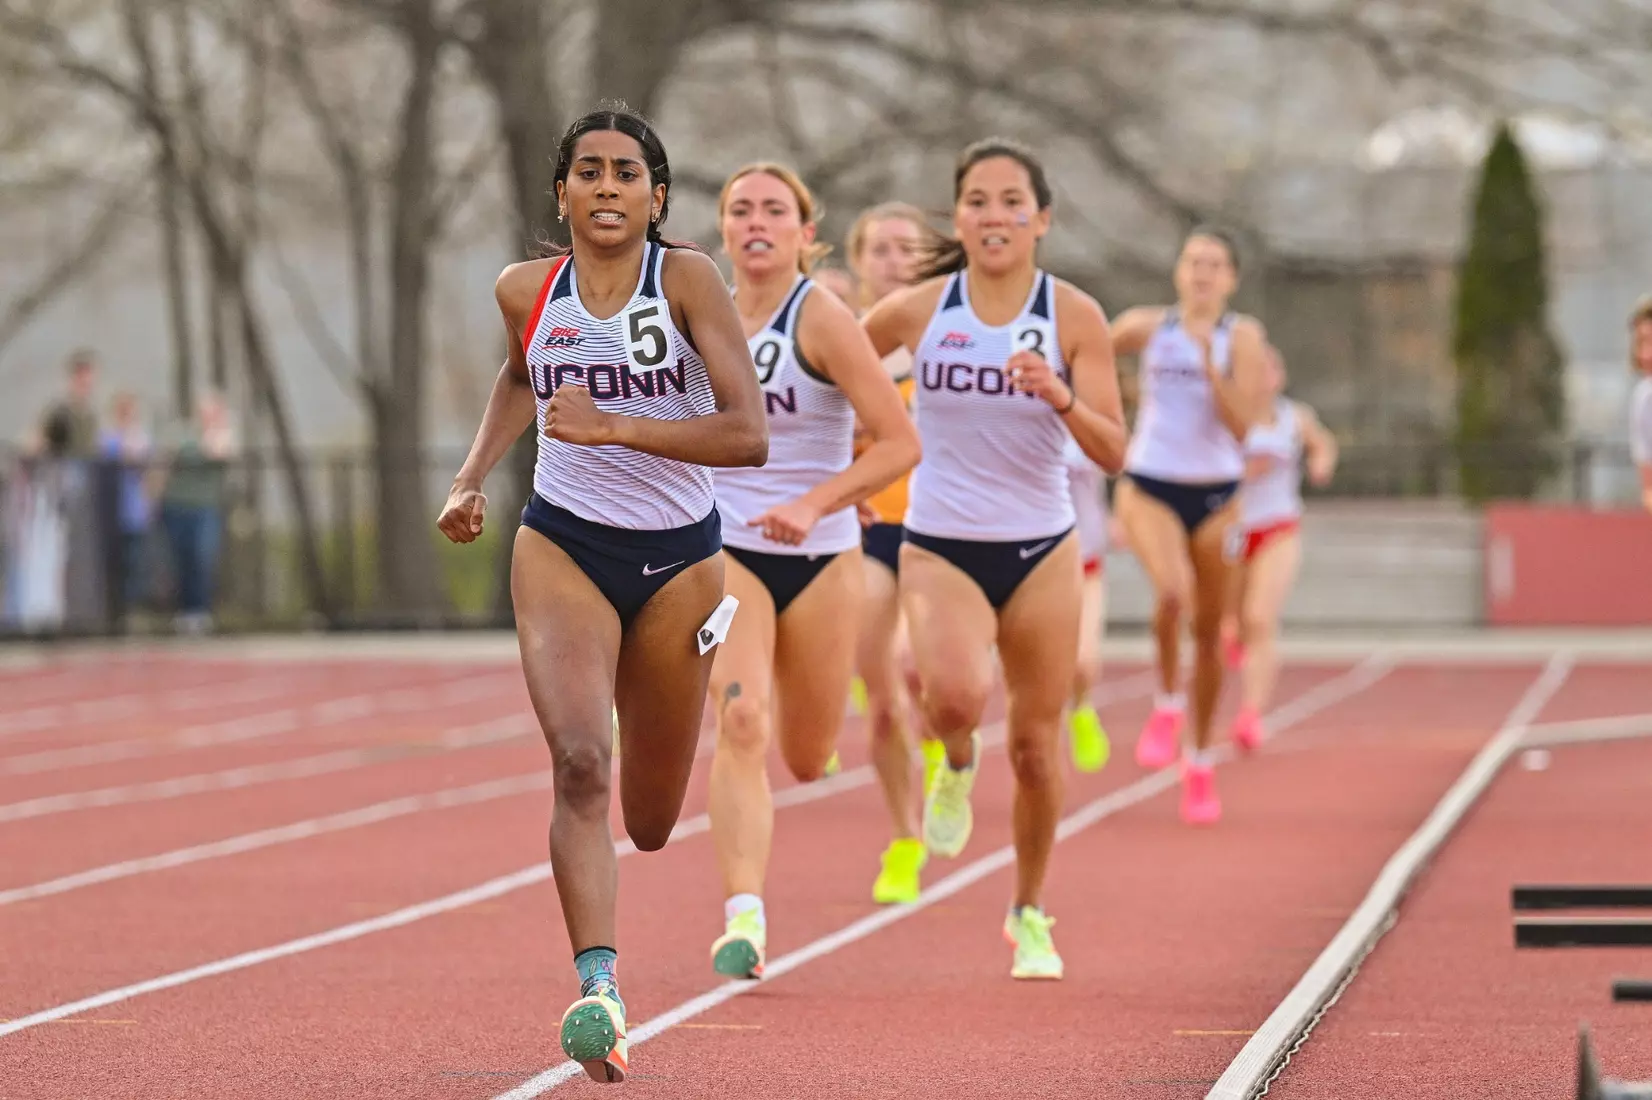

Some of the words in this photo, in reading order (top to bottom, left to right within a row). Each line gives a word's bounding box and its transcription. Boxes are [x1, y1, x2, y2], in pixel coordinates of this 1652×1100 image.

[545, 337, 586, 346] EAST
[550, 327, 580, 337] BIG
[628, 306, 667, 366] 5
[1018, 329, 1046, 361] 3
[754, 341, 780, 384] 9
[922, 361, 1071, 398] UCO
